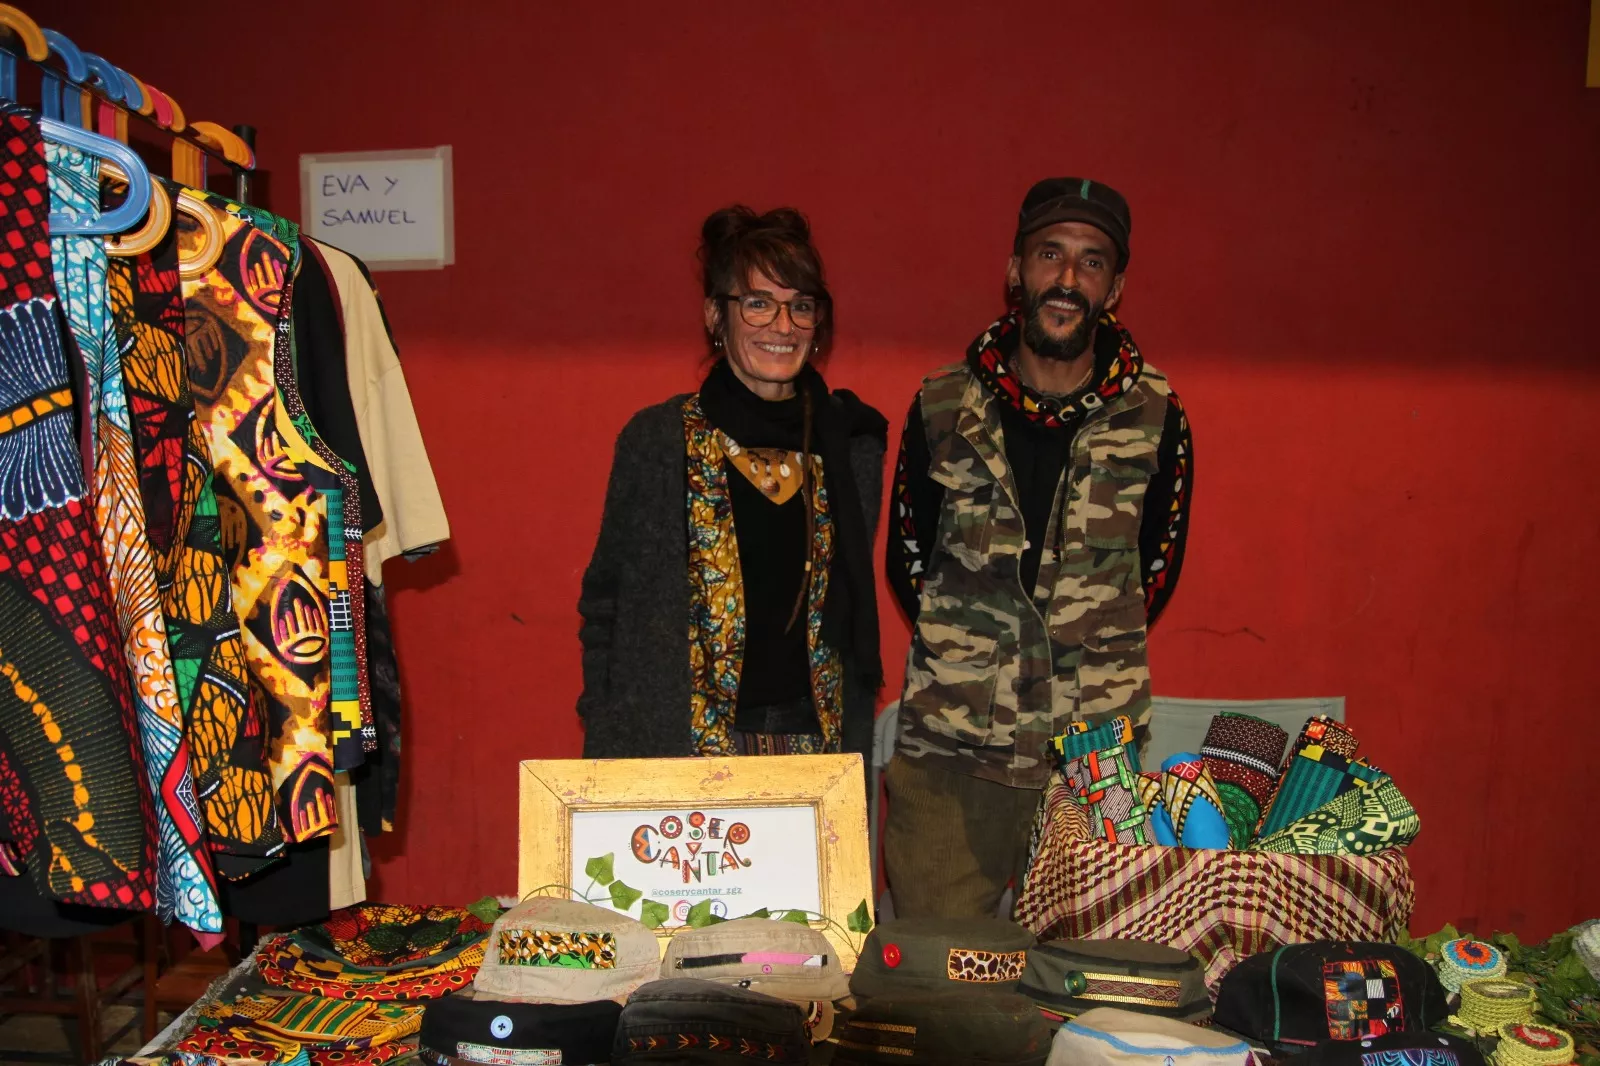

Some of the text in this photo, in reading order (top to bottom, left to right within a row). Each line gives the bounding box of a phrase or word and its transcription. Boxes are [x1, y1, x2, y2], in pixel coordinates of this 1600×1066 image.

[322, 174, 370, 197] EVA
[321, 208, 416, 227] SAMUEL
[651, 886, 743, 898] @coserycantar_zgz
